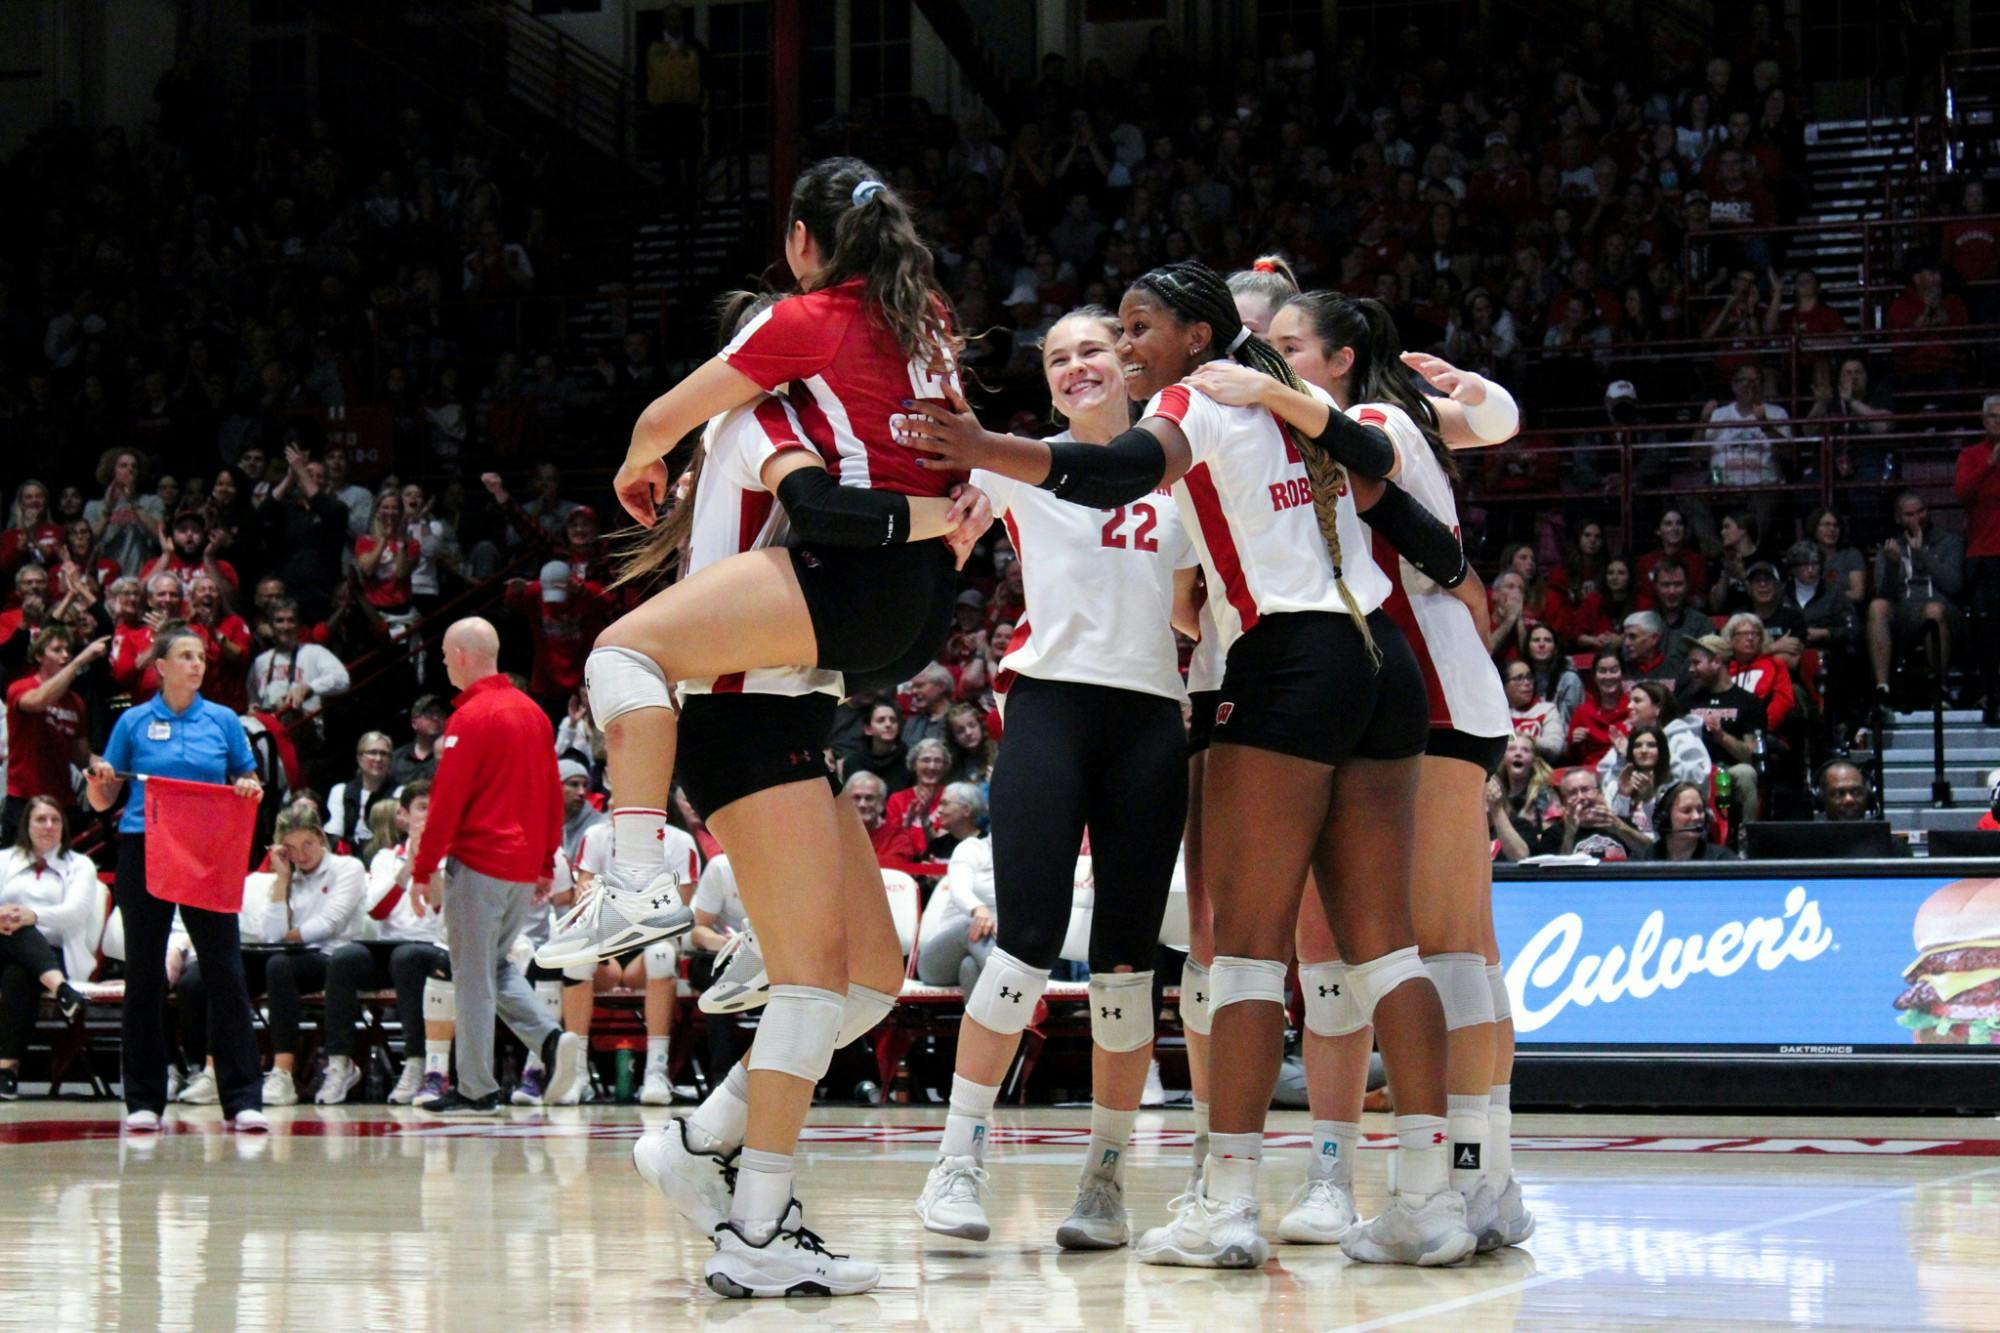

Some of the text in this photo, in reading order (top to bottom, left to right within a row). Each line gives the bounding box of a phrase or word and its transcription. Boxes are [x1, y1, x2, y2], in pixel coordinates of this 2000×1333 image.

[1101, 502, 1158, 553] 22
[1504, 885, 1833, 1033] Culver's
[1779, 1045, 1854, 1054] DAKTRONICS
